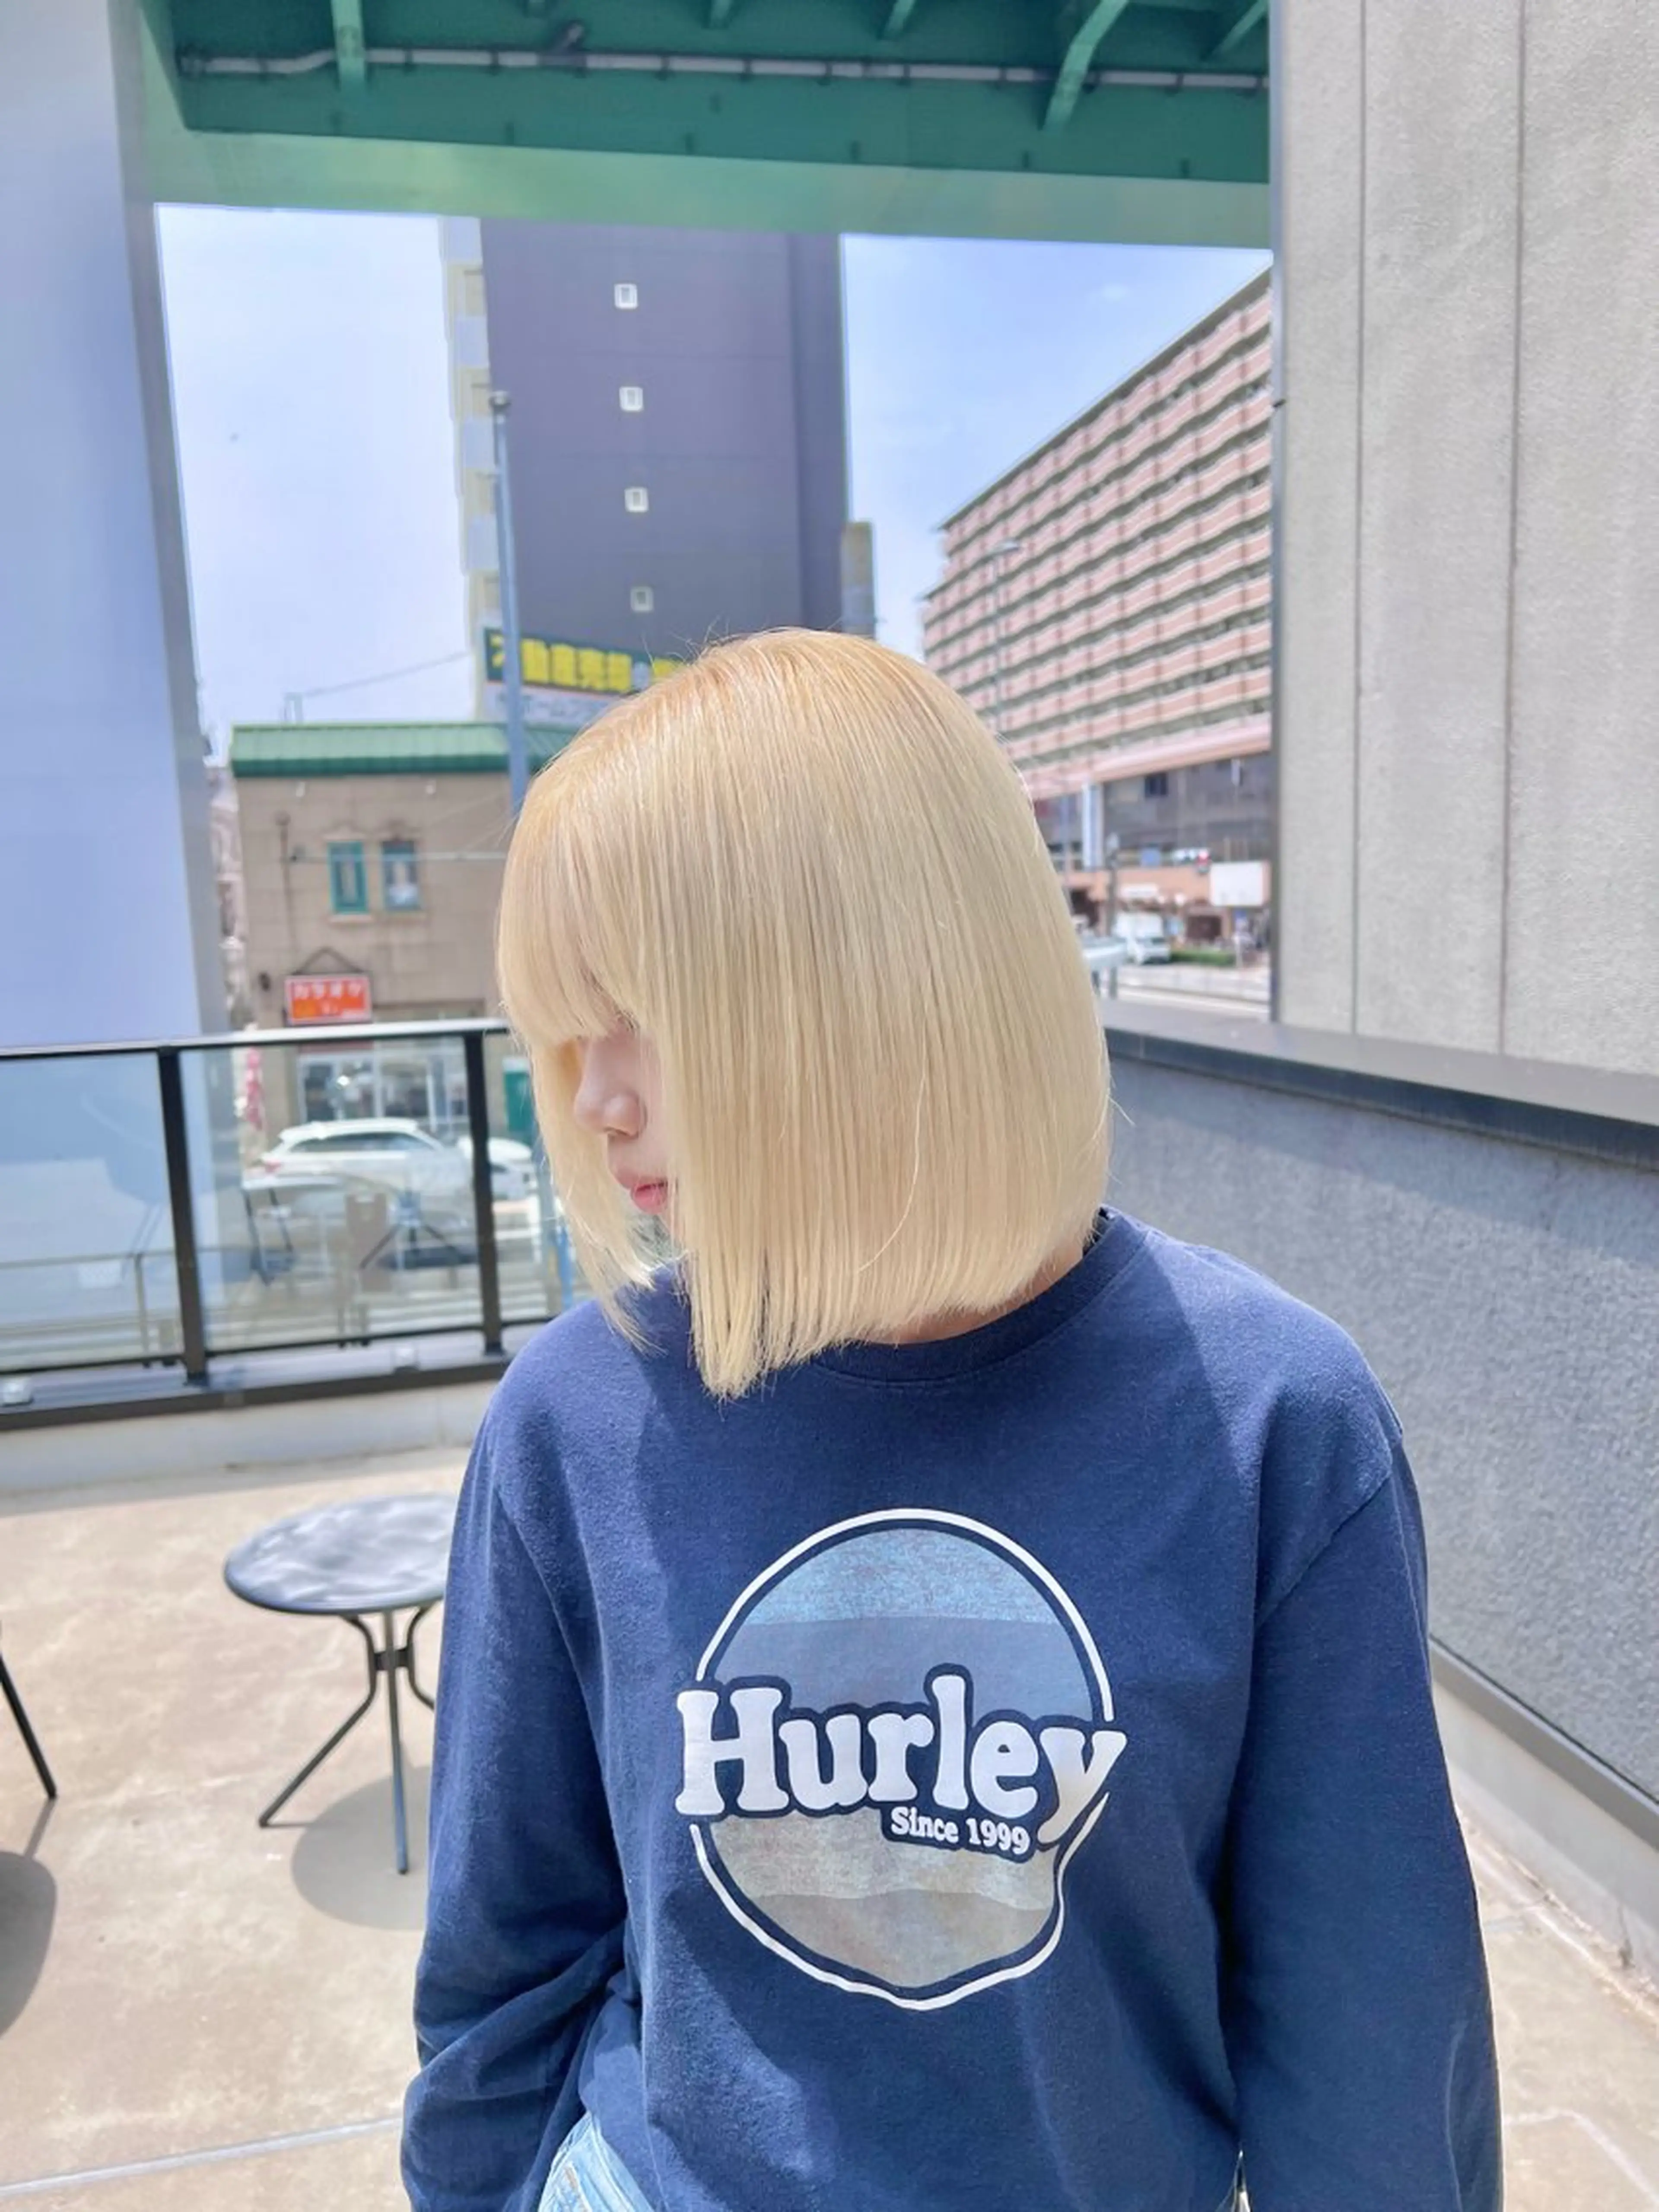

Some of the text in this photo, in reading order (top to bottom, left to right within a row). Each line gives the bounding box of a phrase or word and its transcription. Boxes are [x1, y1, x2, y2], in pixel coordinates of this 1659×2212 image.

[675, 1675, 1127, 1843] Hurley
[891, 1806, 1030, 1855] Since 1999
